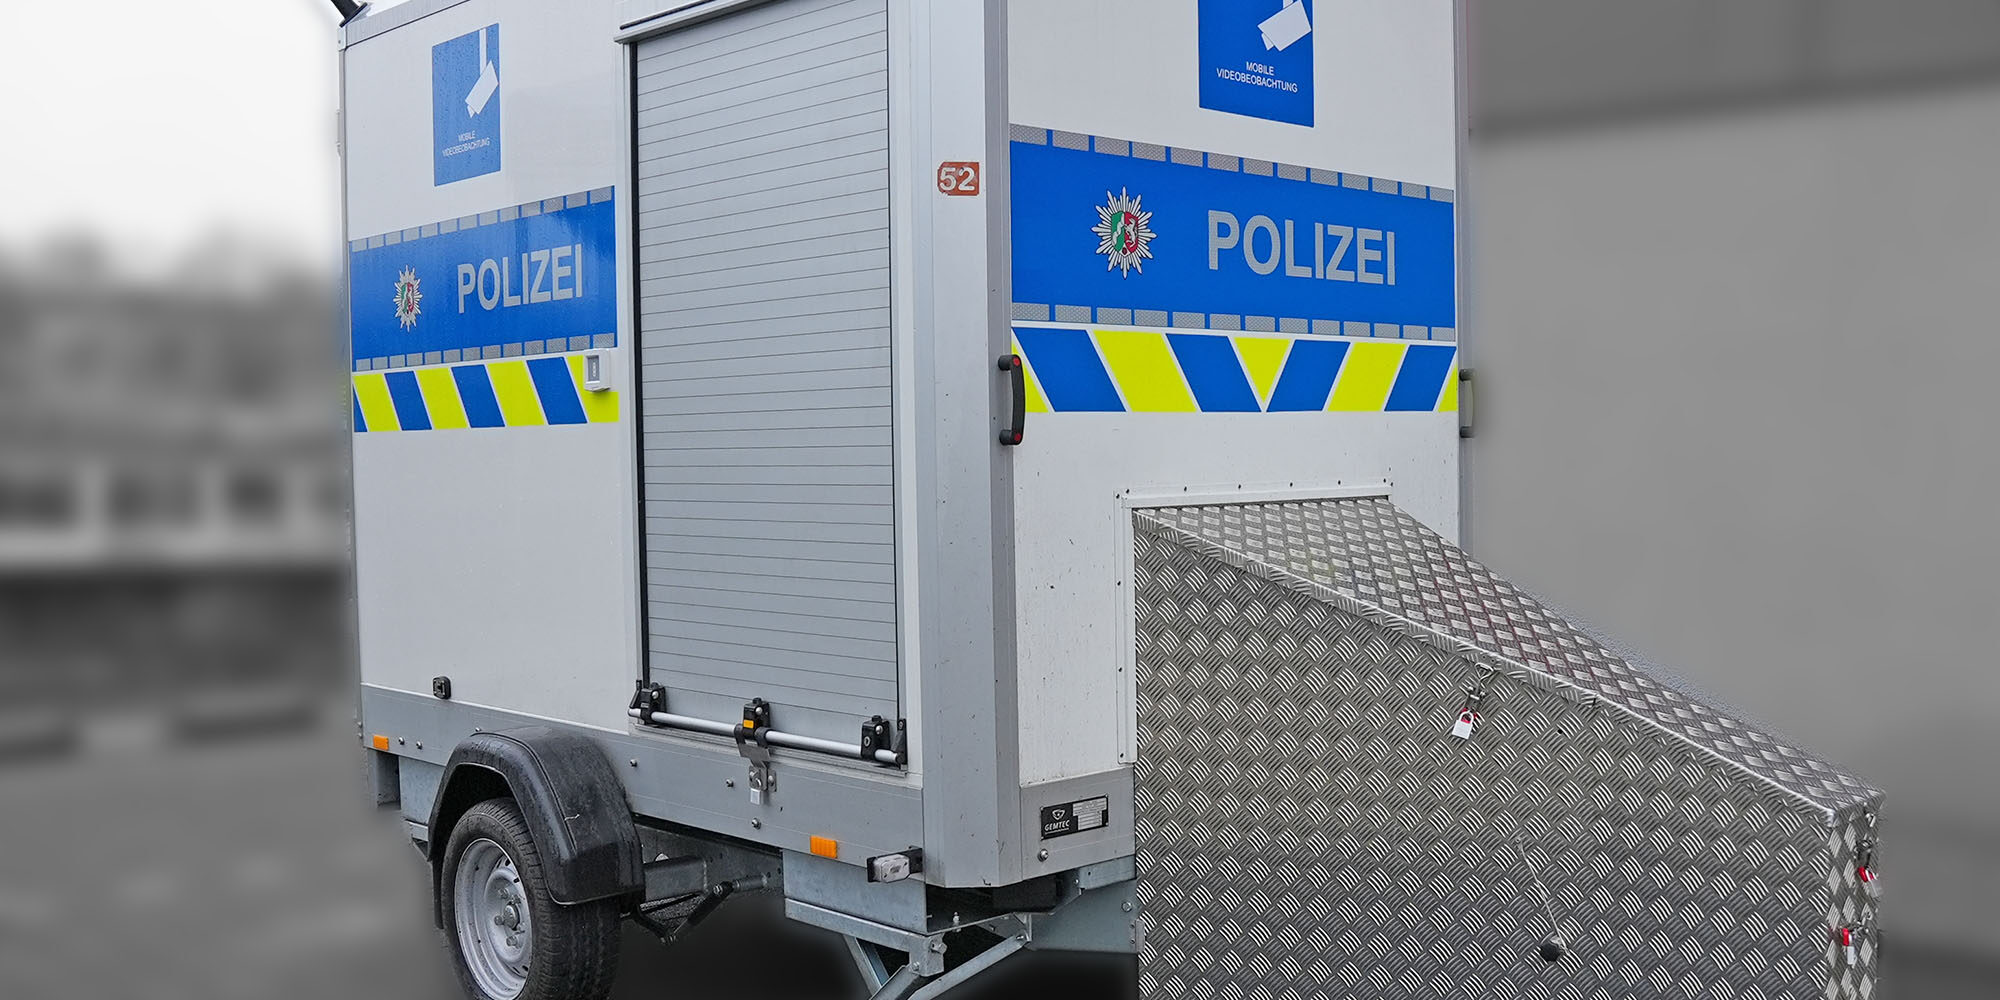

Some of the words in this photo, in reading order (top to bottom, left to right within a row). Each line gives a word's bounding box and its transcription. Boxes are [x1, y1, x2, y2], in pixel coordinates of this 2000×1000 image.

[1216, 67, 1298, 93] VIDEOBEOBACHTUNG
[1245, 61, 1275, 76] MOBILE
[458, 130, 476, 142] MOBILE
[940, 166, 975, 191] 52
[1208, 209, 1396, 286] POLIZEI
[457, 243, 583, 314] POLIZEI
[1044, 819, 1070, 831] GEMTEC
